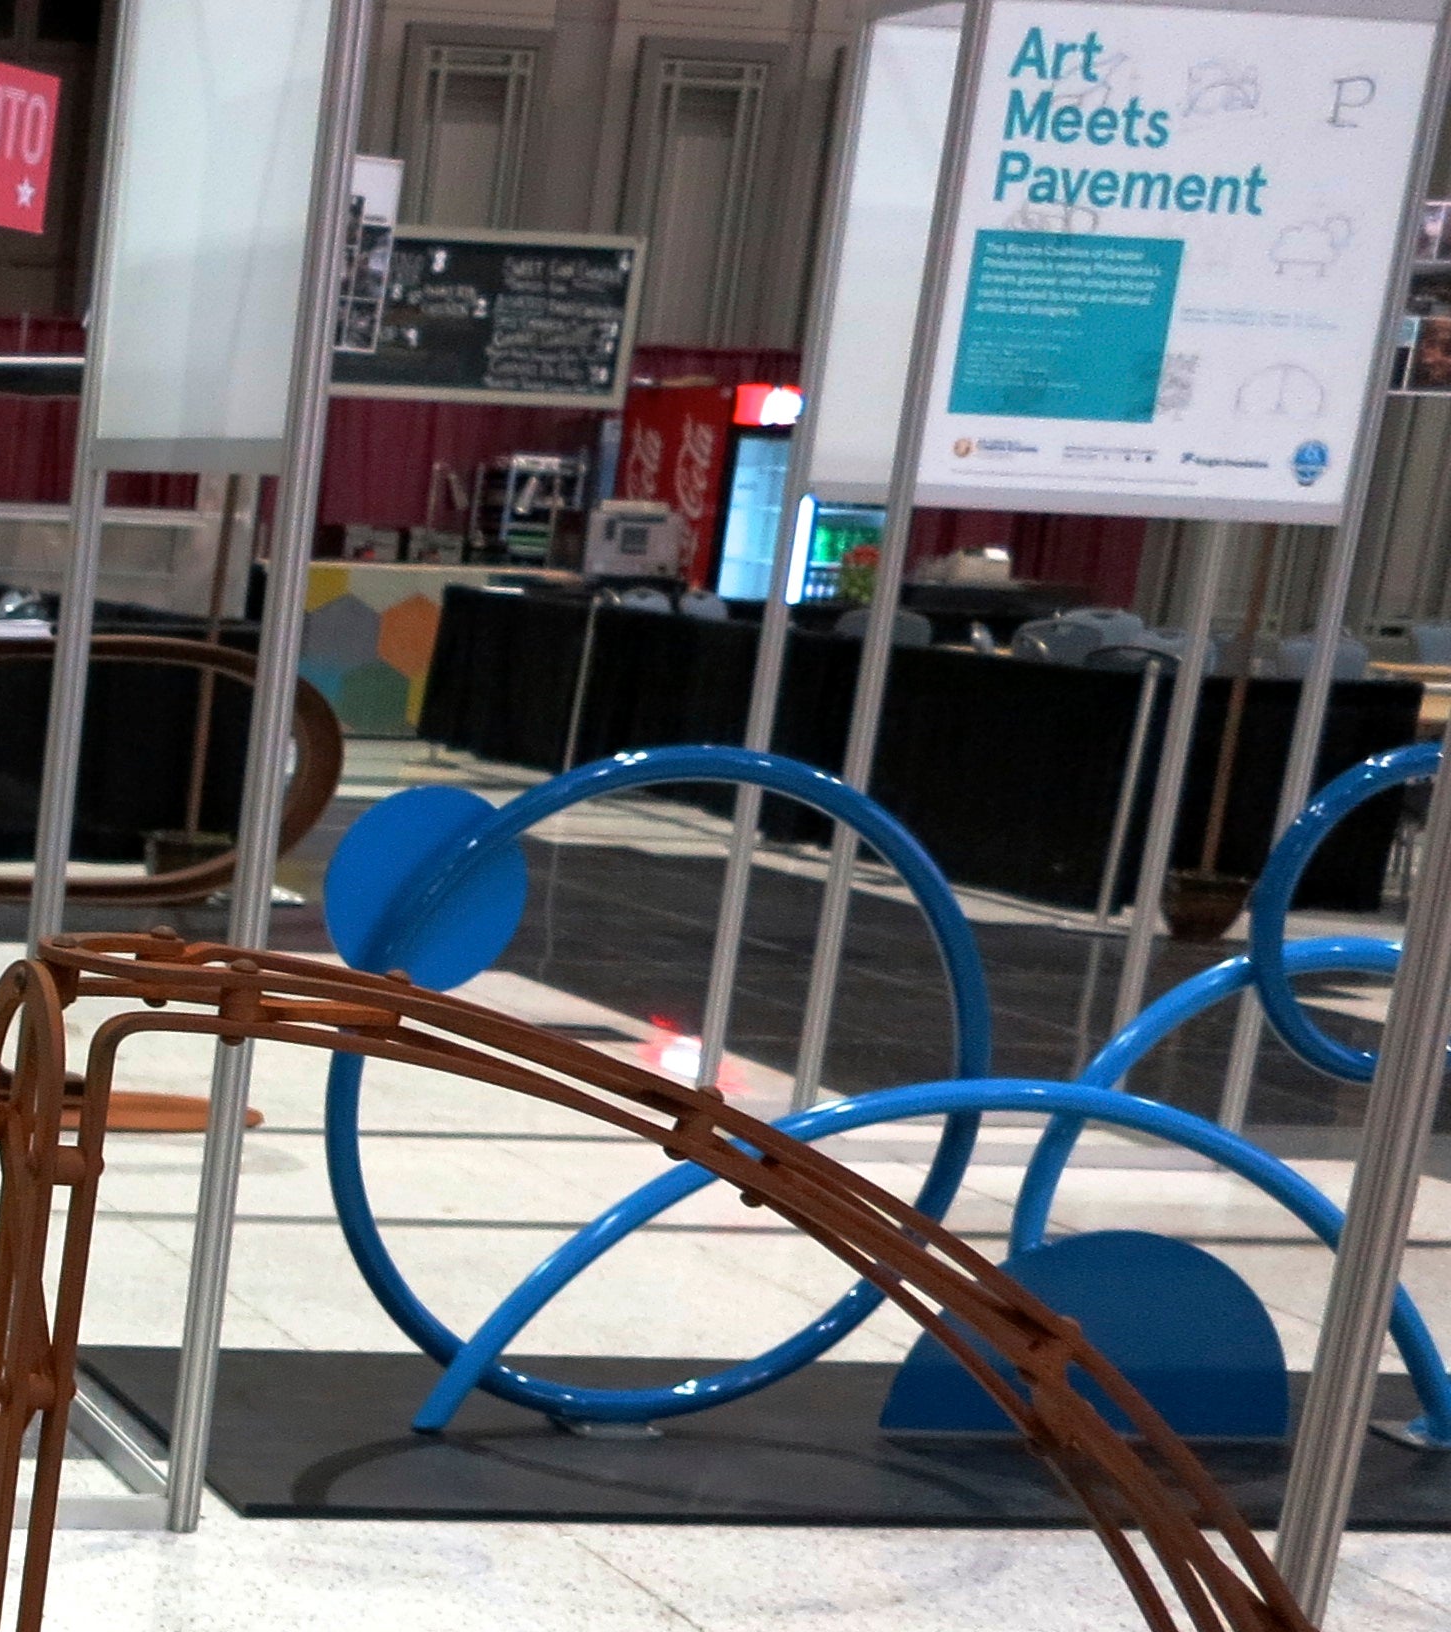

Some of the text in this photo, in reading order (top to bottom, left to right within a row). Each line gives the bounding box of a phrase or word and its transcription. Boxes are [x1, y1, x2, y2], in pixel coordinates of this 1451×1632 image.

[1007, 26, 1104, 82] Art
[1003, 88, 1170, 148] Meets
[992, 149, 1268, 215] Pavement
